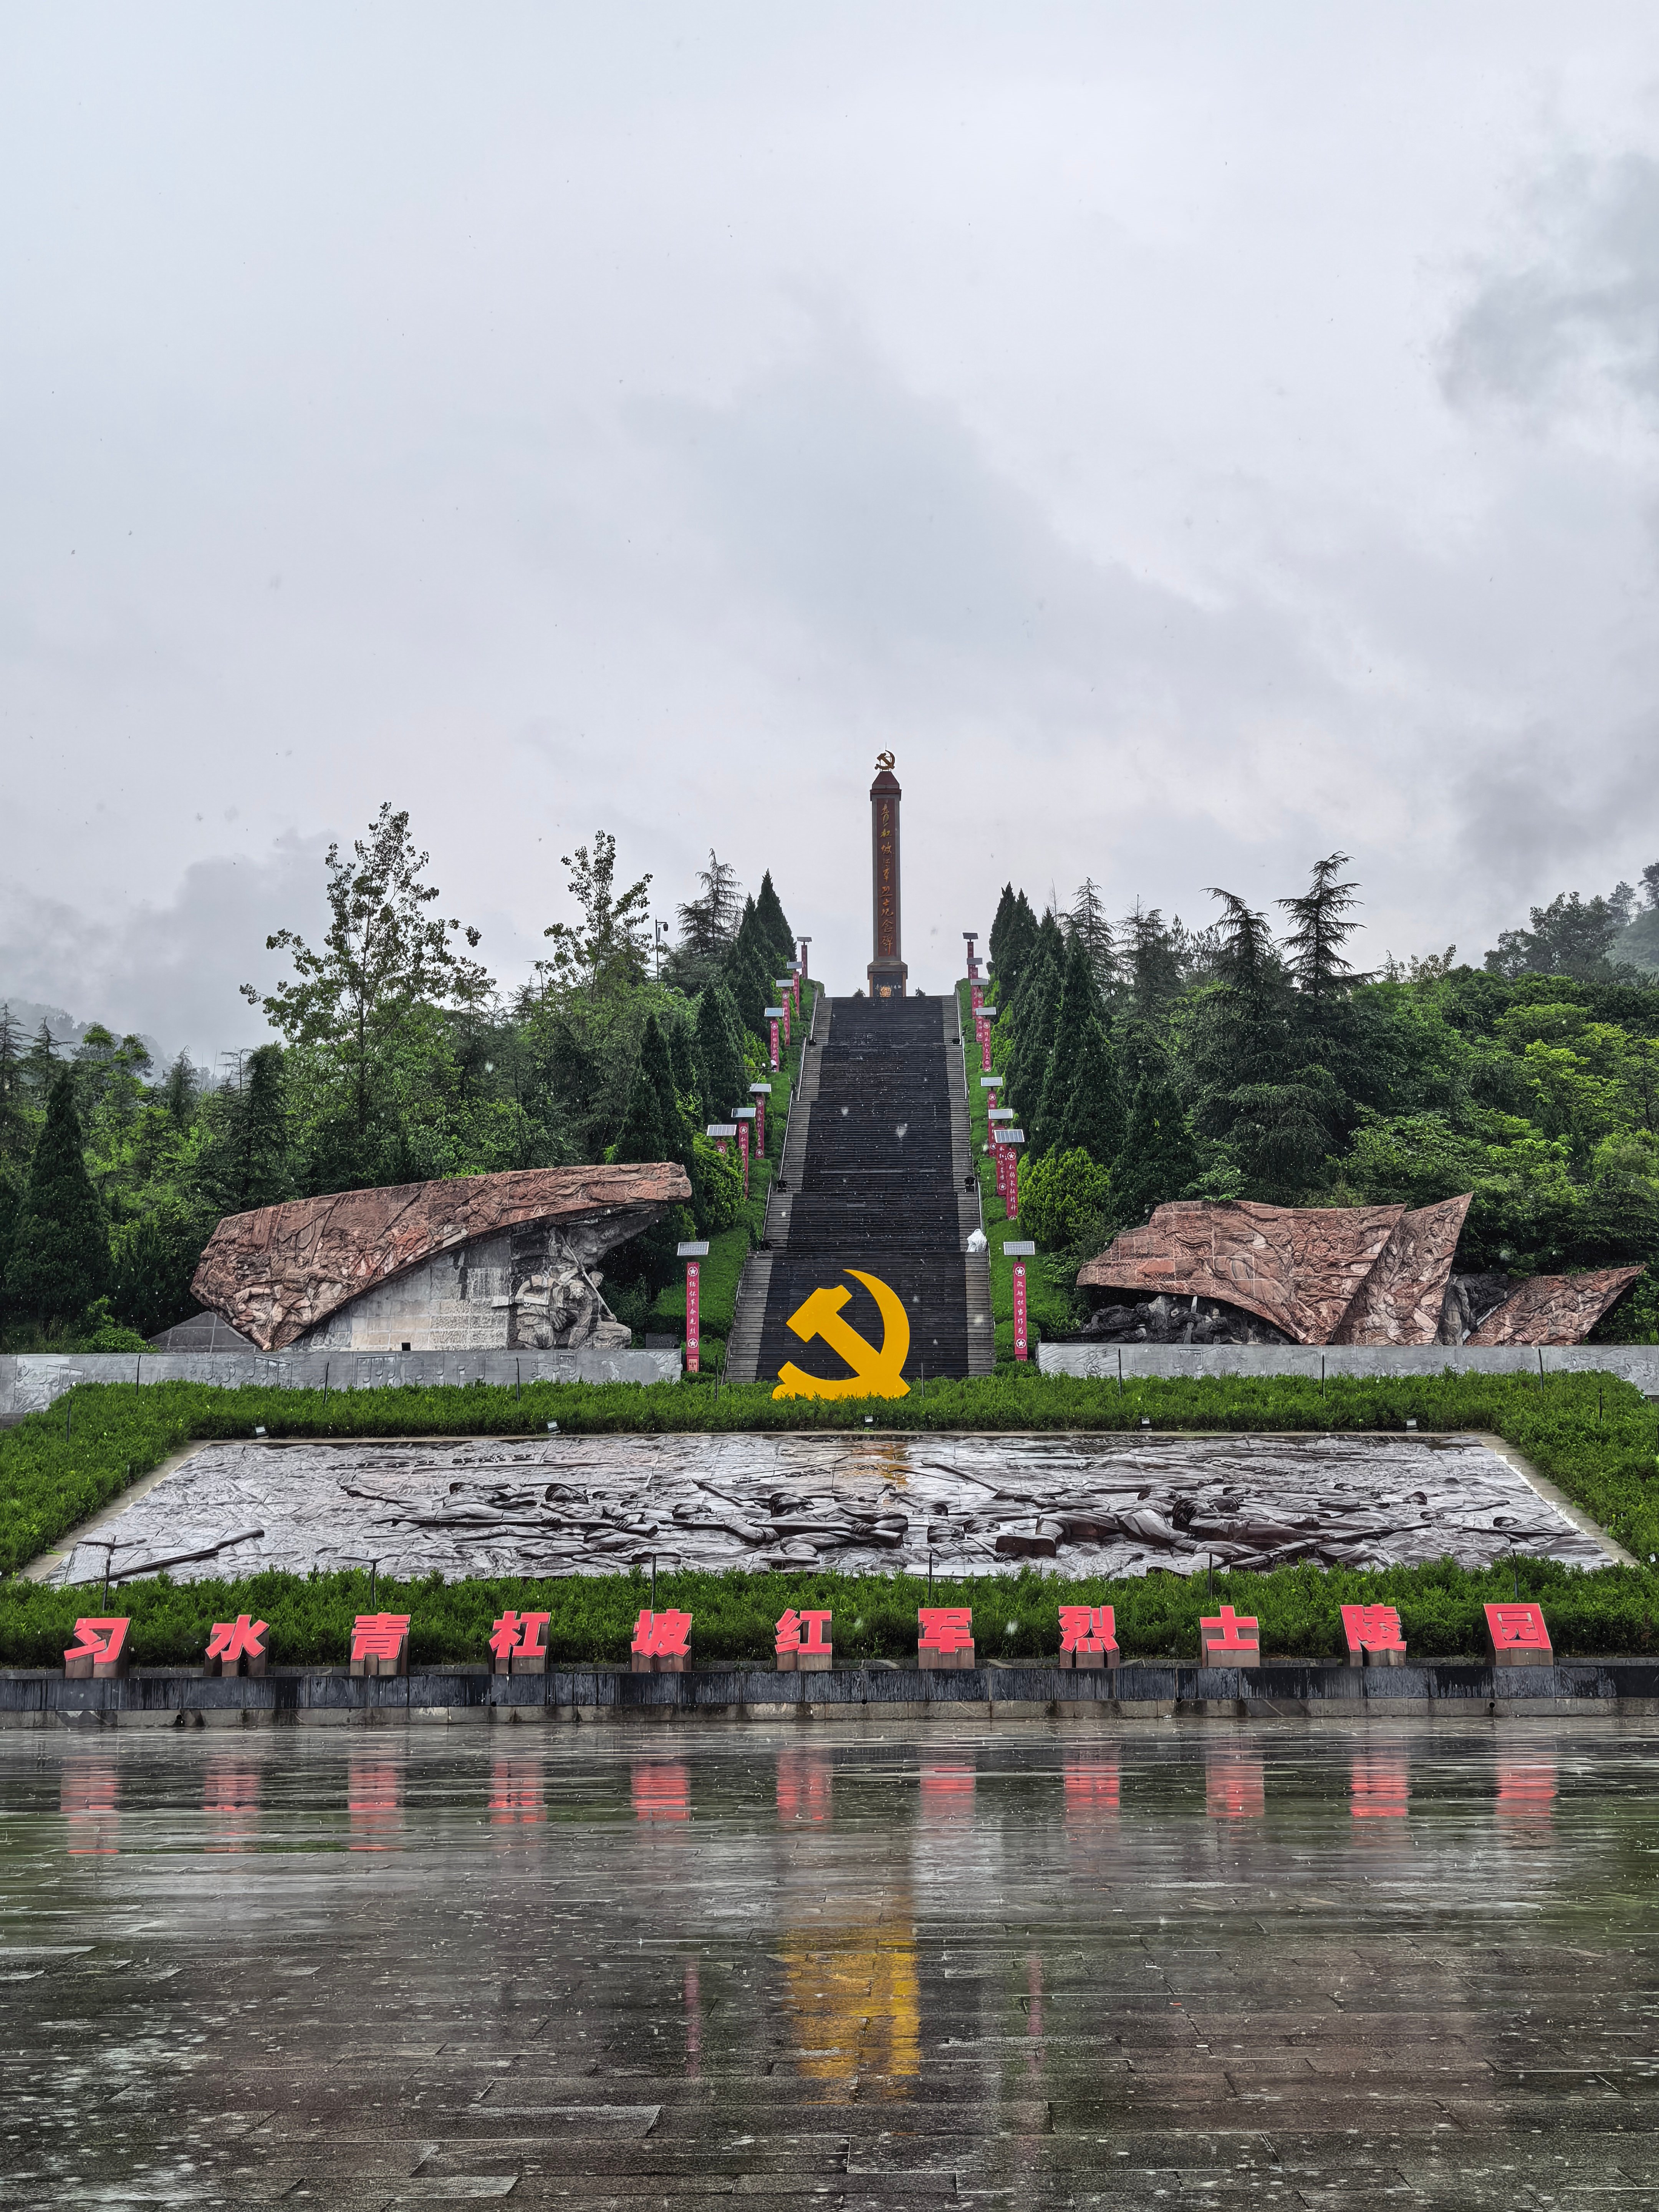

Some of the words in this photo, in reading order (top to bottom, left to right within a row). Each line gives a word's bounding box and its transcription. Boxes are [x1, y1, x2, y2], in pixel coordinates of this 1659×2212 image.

[689, 1281, 697, 1334] 缅怀革命先烈
[63, 1603, 1552, 1664] 习水青杠坡红军烈士陵园
